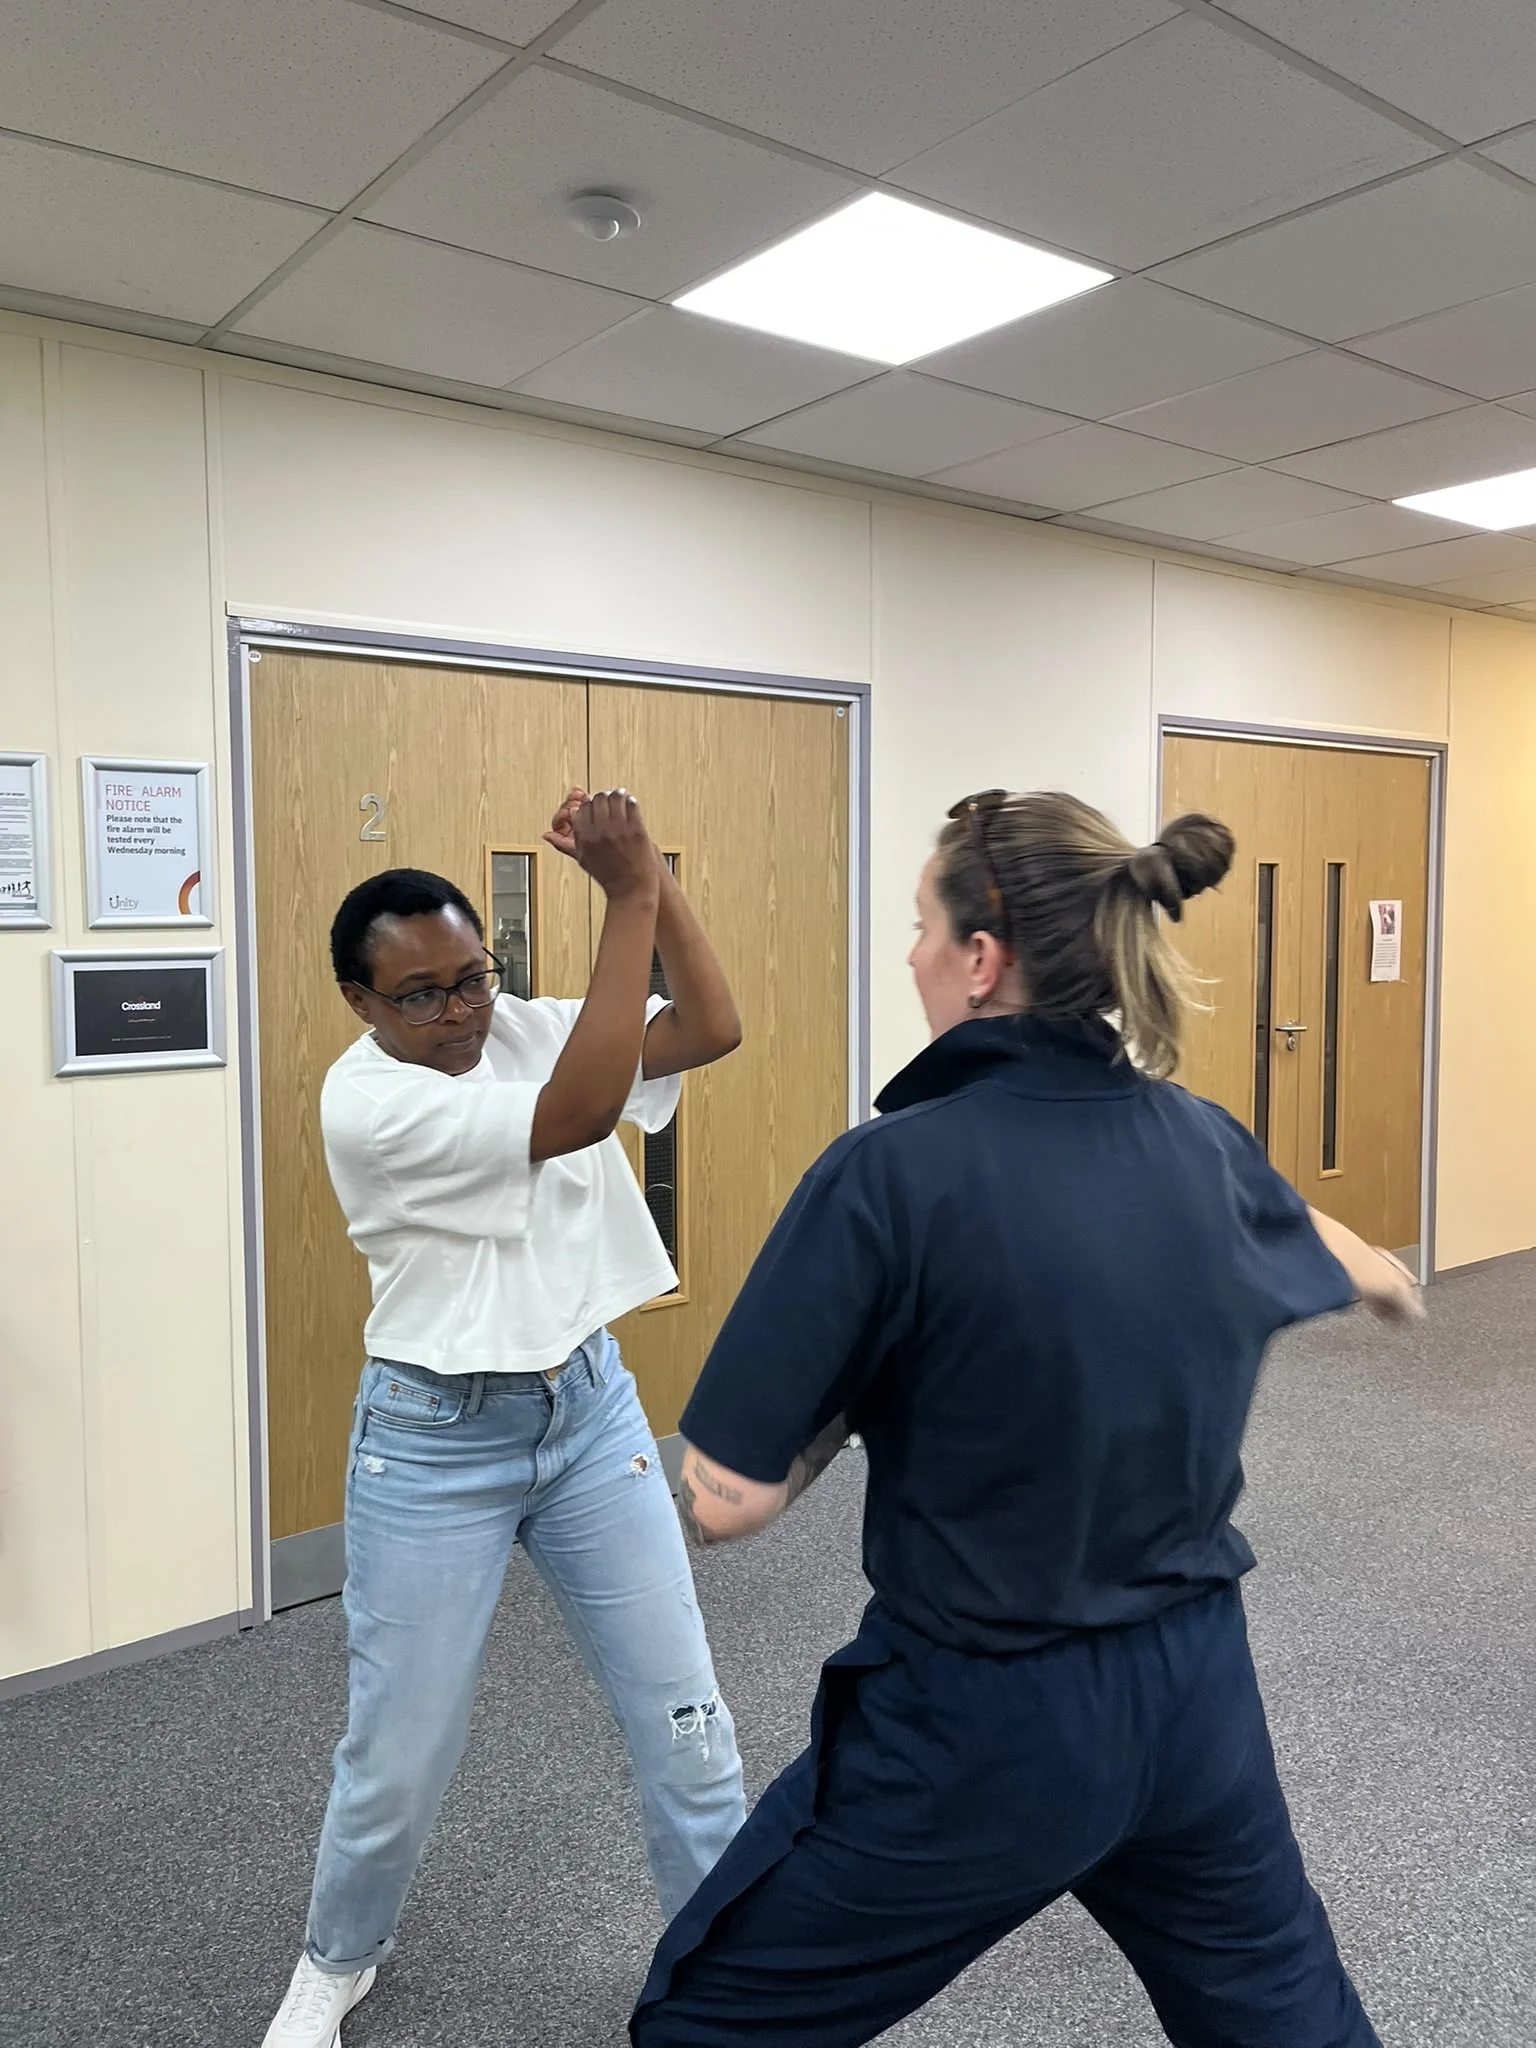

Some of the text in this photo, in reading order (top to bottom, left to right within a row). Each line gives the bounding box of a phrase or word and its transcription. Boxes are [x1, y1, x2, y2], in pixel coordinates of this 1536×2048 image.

[105, 784, 182, 798] FIRE ALARM
[105, 799, 151, 812] NOTICE
[106, 814, 133, 823] Please
[153, 816, 168, 824] that
[170, 816, 183, 824] the
[359, 792, 386, 842] 2
[106, 824, 120, 833] fire
[122, 825, 144, 833] alarm
[162, 826, 172, 834] be
[133, 837, 155, 845] every
[107, 846, 186, 856] Wednesday morning
[109, 895, 140, 911] Unity
[121, 1000, 161, 1011] Crossland
